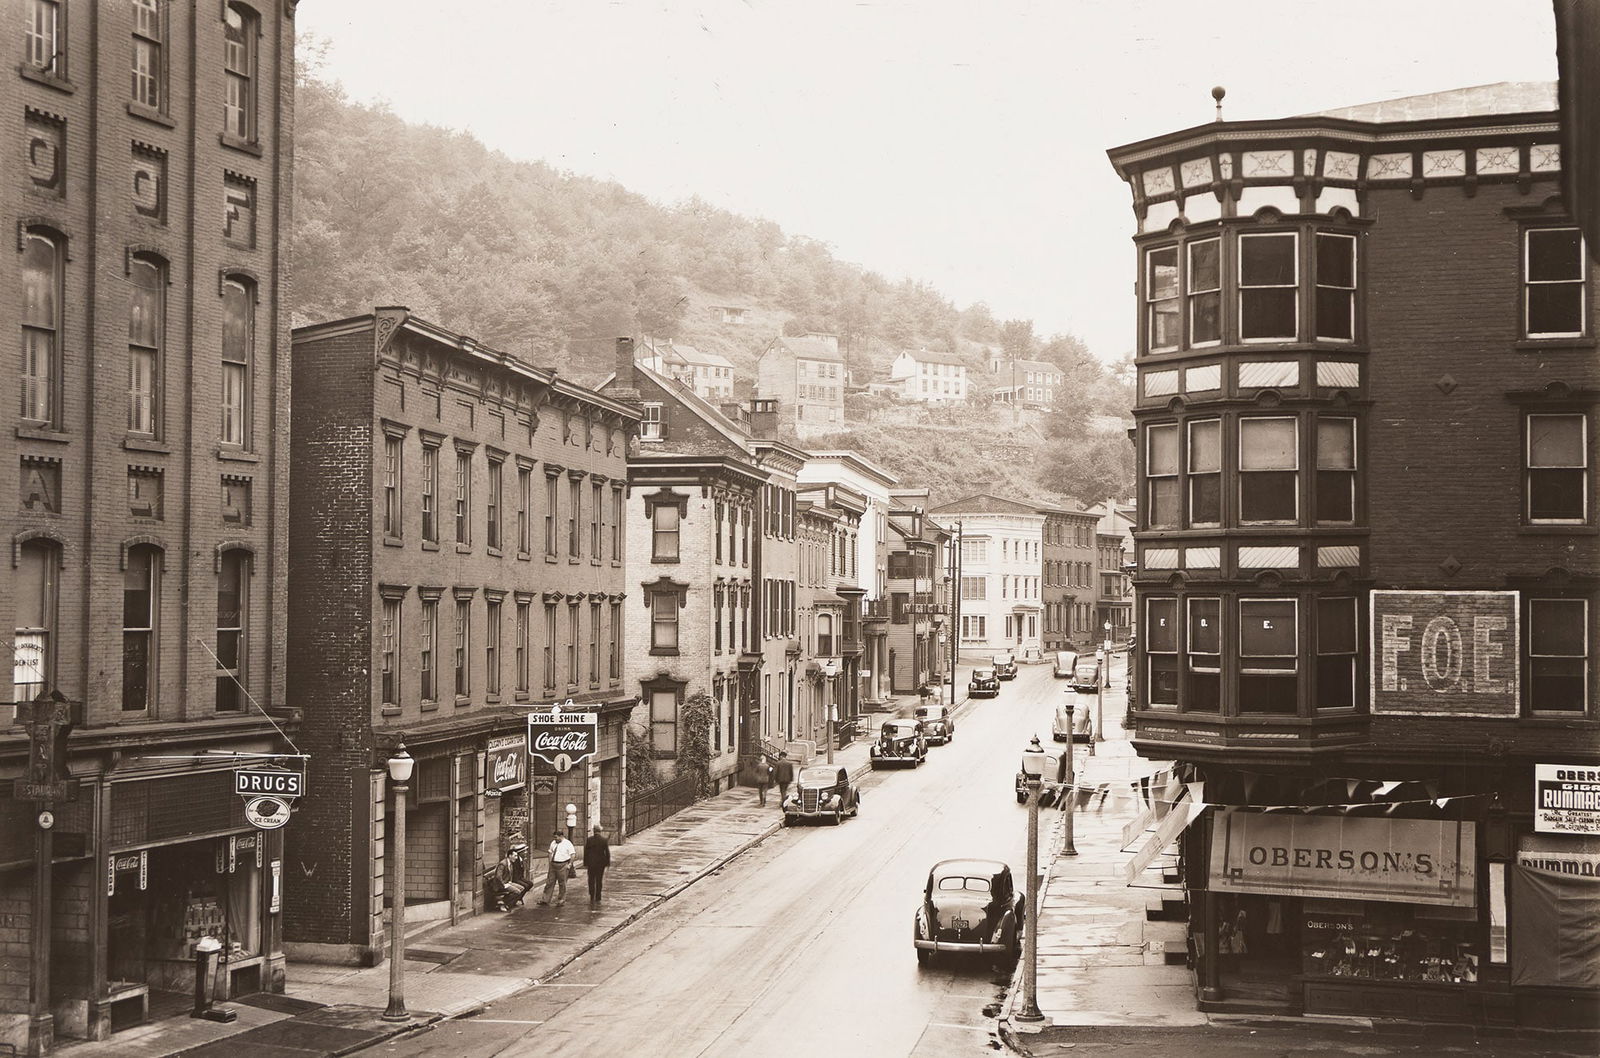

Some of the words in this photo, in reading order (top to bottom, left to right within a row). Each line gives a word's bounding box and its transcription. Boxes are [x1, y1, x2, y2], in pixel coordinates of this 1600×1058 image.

[532, 715, 554, 723] SHOE
[558, 715, 585, 723] SHINE
[535, 731, 590, 751] Coca-Cola
[239, 775, 298, 792] DRUGS
[1249, 846, 1433, 874] OBERSON'S
